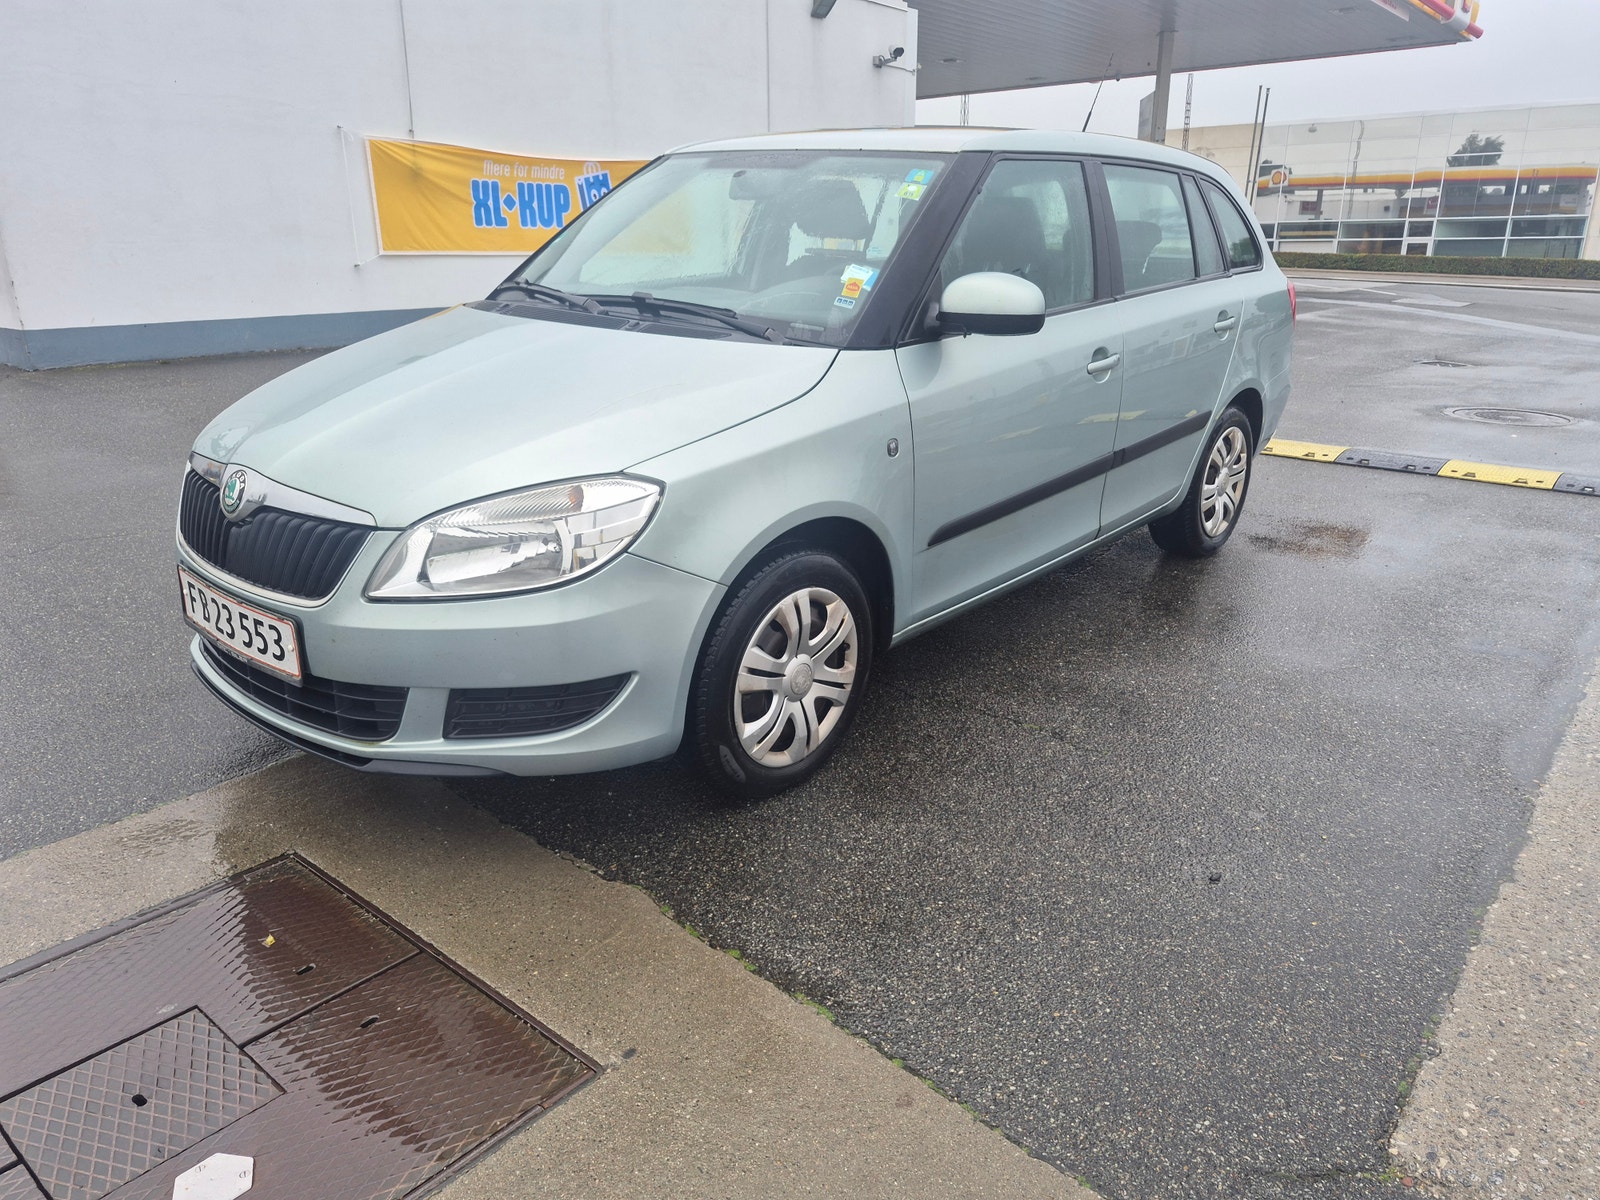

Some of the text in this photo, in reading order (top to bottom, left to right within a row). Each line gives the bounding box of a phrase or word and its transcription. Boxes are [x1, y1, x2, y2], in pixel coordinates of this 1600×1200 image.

[483, 160, 565, 179] Mere for mindre
[239, 611, 286, 662] 553
